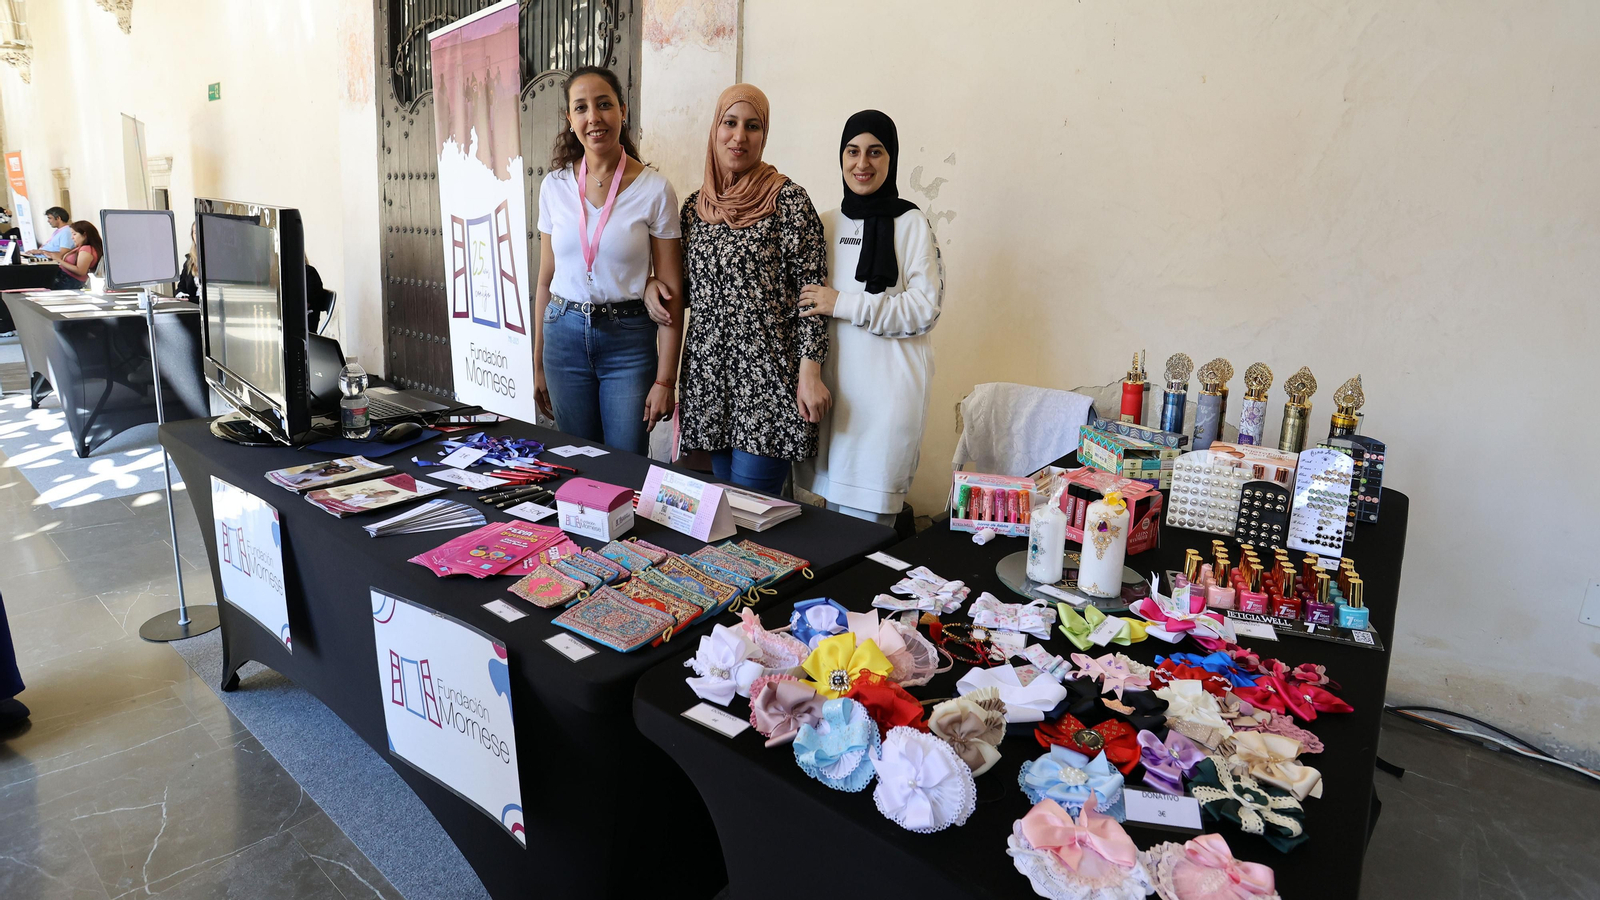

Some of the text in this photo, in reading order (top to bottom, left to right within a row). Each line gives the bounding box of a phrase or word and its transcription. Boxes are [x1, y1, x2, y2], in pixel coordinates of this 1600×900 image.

[839, 237, 862, 246] PUMA
[472, 240, 486, 276] 25
[469, 342, 509, 370] Fundación
[465, 356, 516, 399] Mornese
[505, 526, 534, 537] FERIA
[246, 540, 274, 568] Fundación
[248, 553, 283, 596] Mornese
[1245, 600, 1254, 610] 7
[1279, 605, 1288, 615] 7
[1312, 610, 1322, 620] 7
[1346, 616, 1355, 627] 7
[1303, 622, 1317, 633] 7
[437, 678, 490, 723] Fundación
[710, 708, 738, 722] DONATIVO
[439, 696, 510, 764] Mornese
[1141, 791, 1180, 802] DONATIVO
[1157, 810, 1166, 818] 3€
